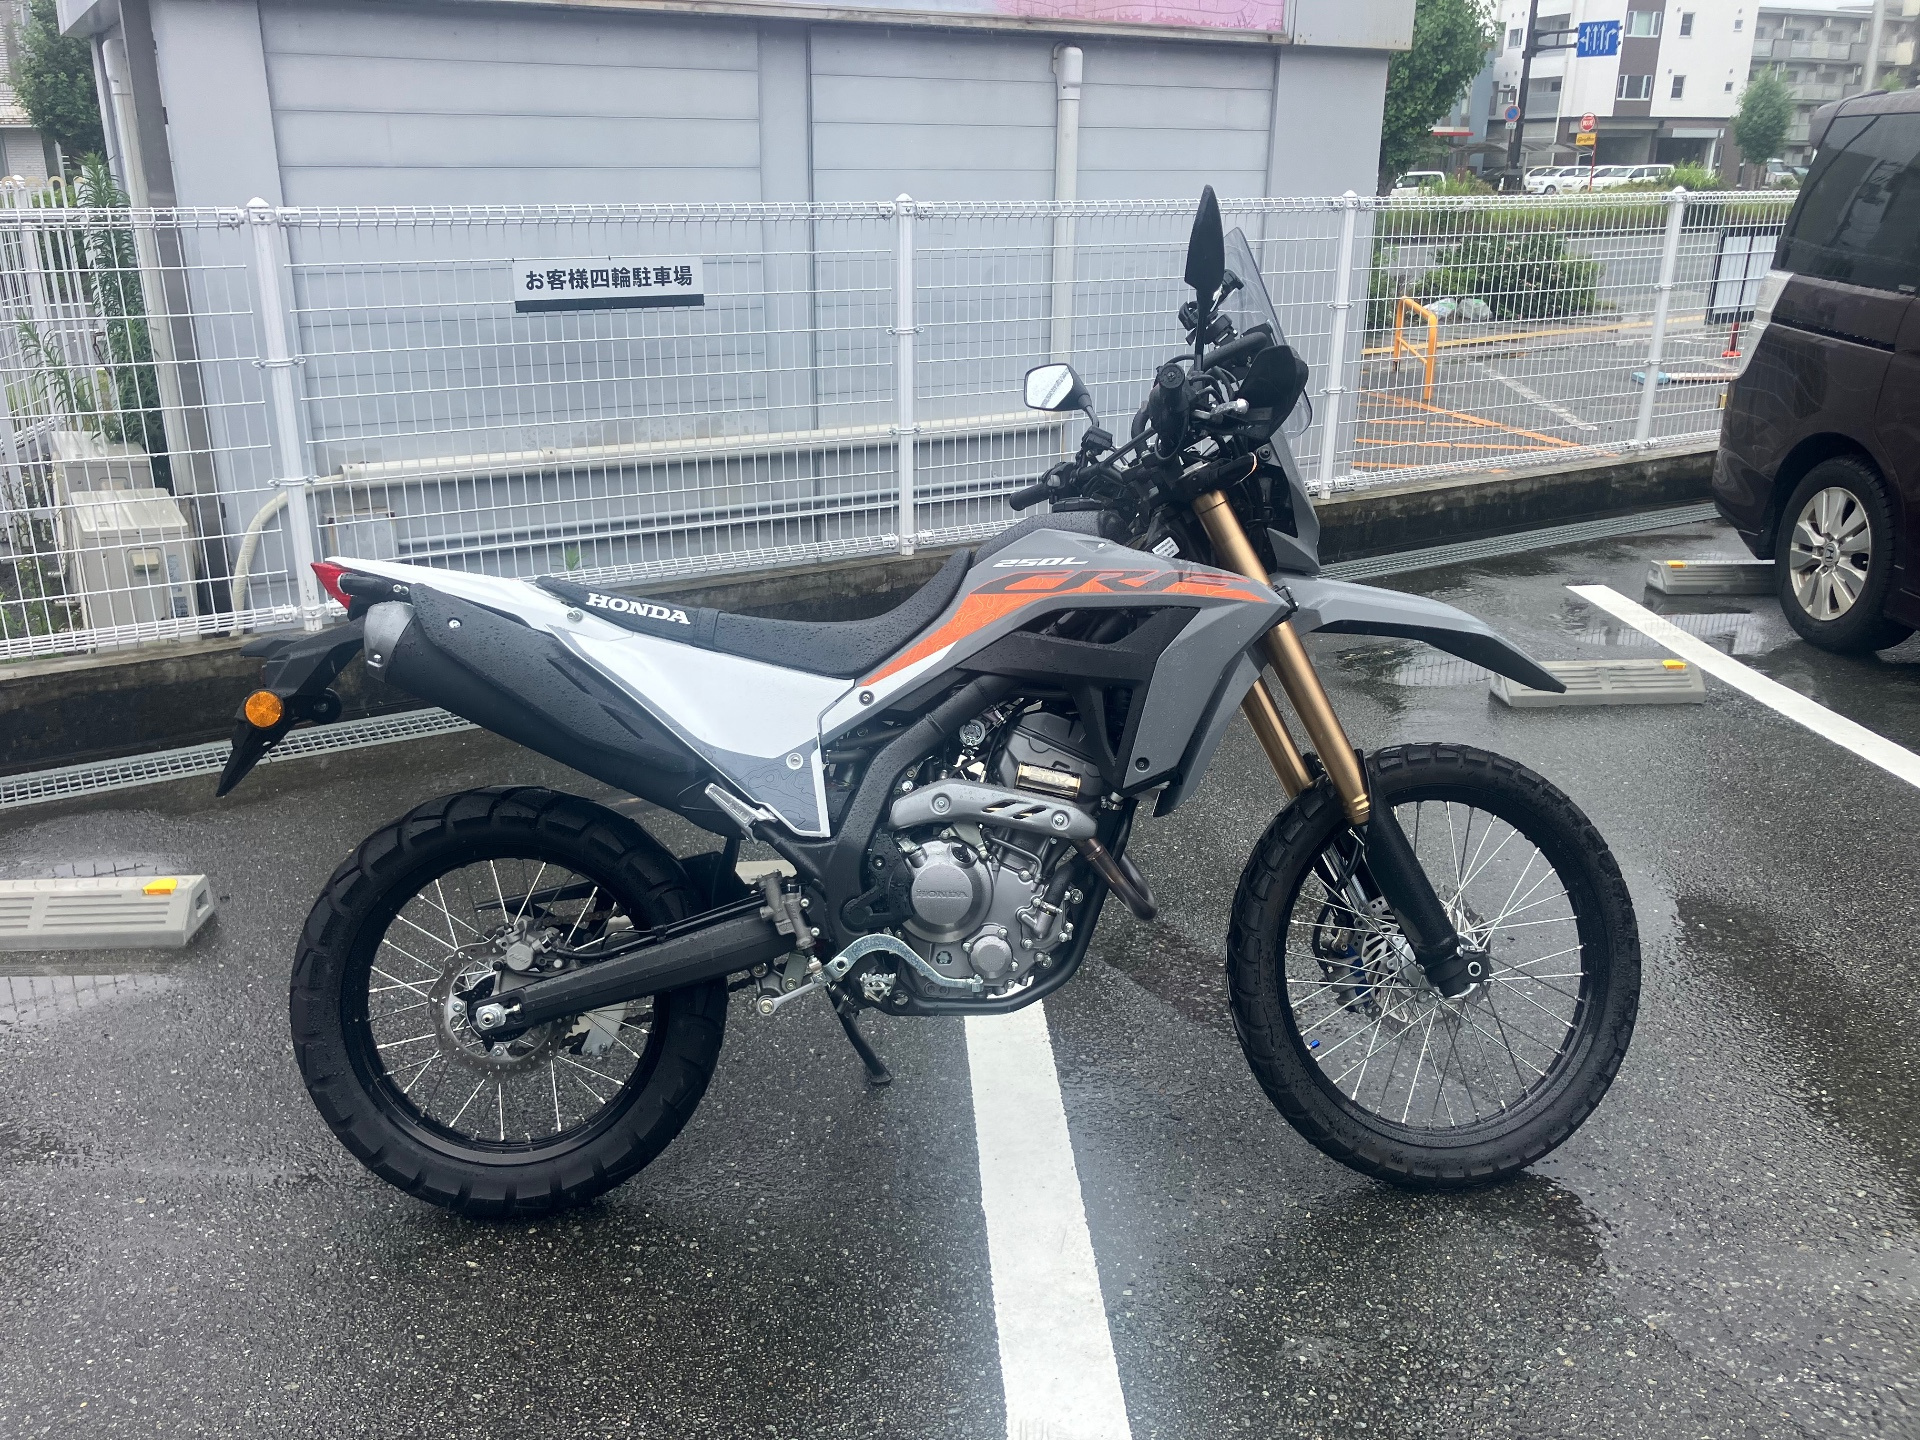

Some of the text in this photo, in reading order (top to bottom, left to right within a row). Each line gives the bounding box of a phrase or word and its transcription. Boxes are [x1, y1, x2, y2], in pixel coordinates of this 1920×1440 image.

[525, 265, 693, 291] お客様四輪駐車場
[992, 555, 1089, 568] 250L
[968, 569, 1251, 595] CRF
[585, 592, 691, 625] HONDA
[915, 889, 969, 899] HONDA
